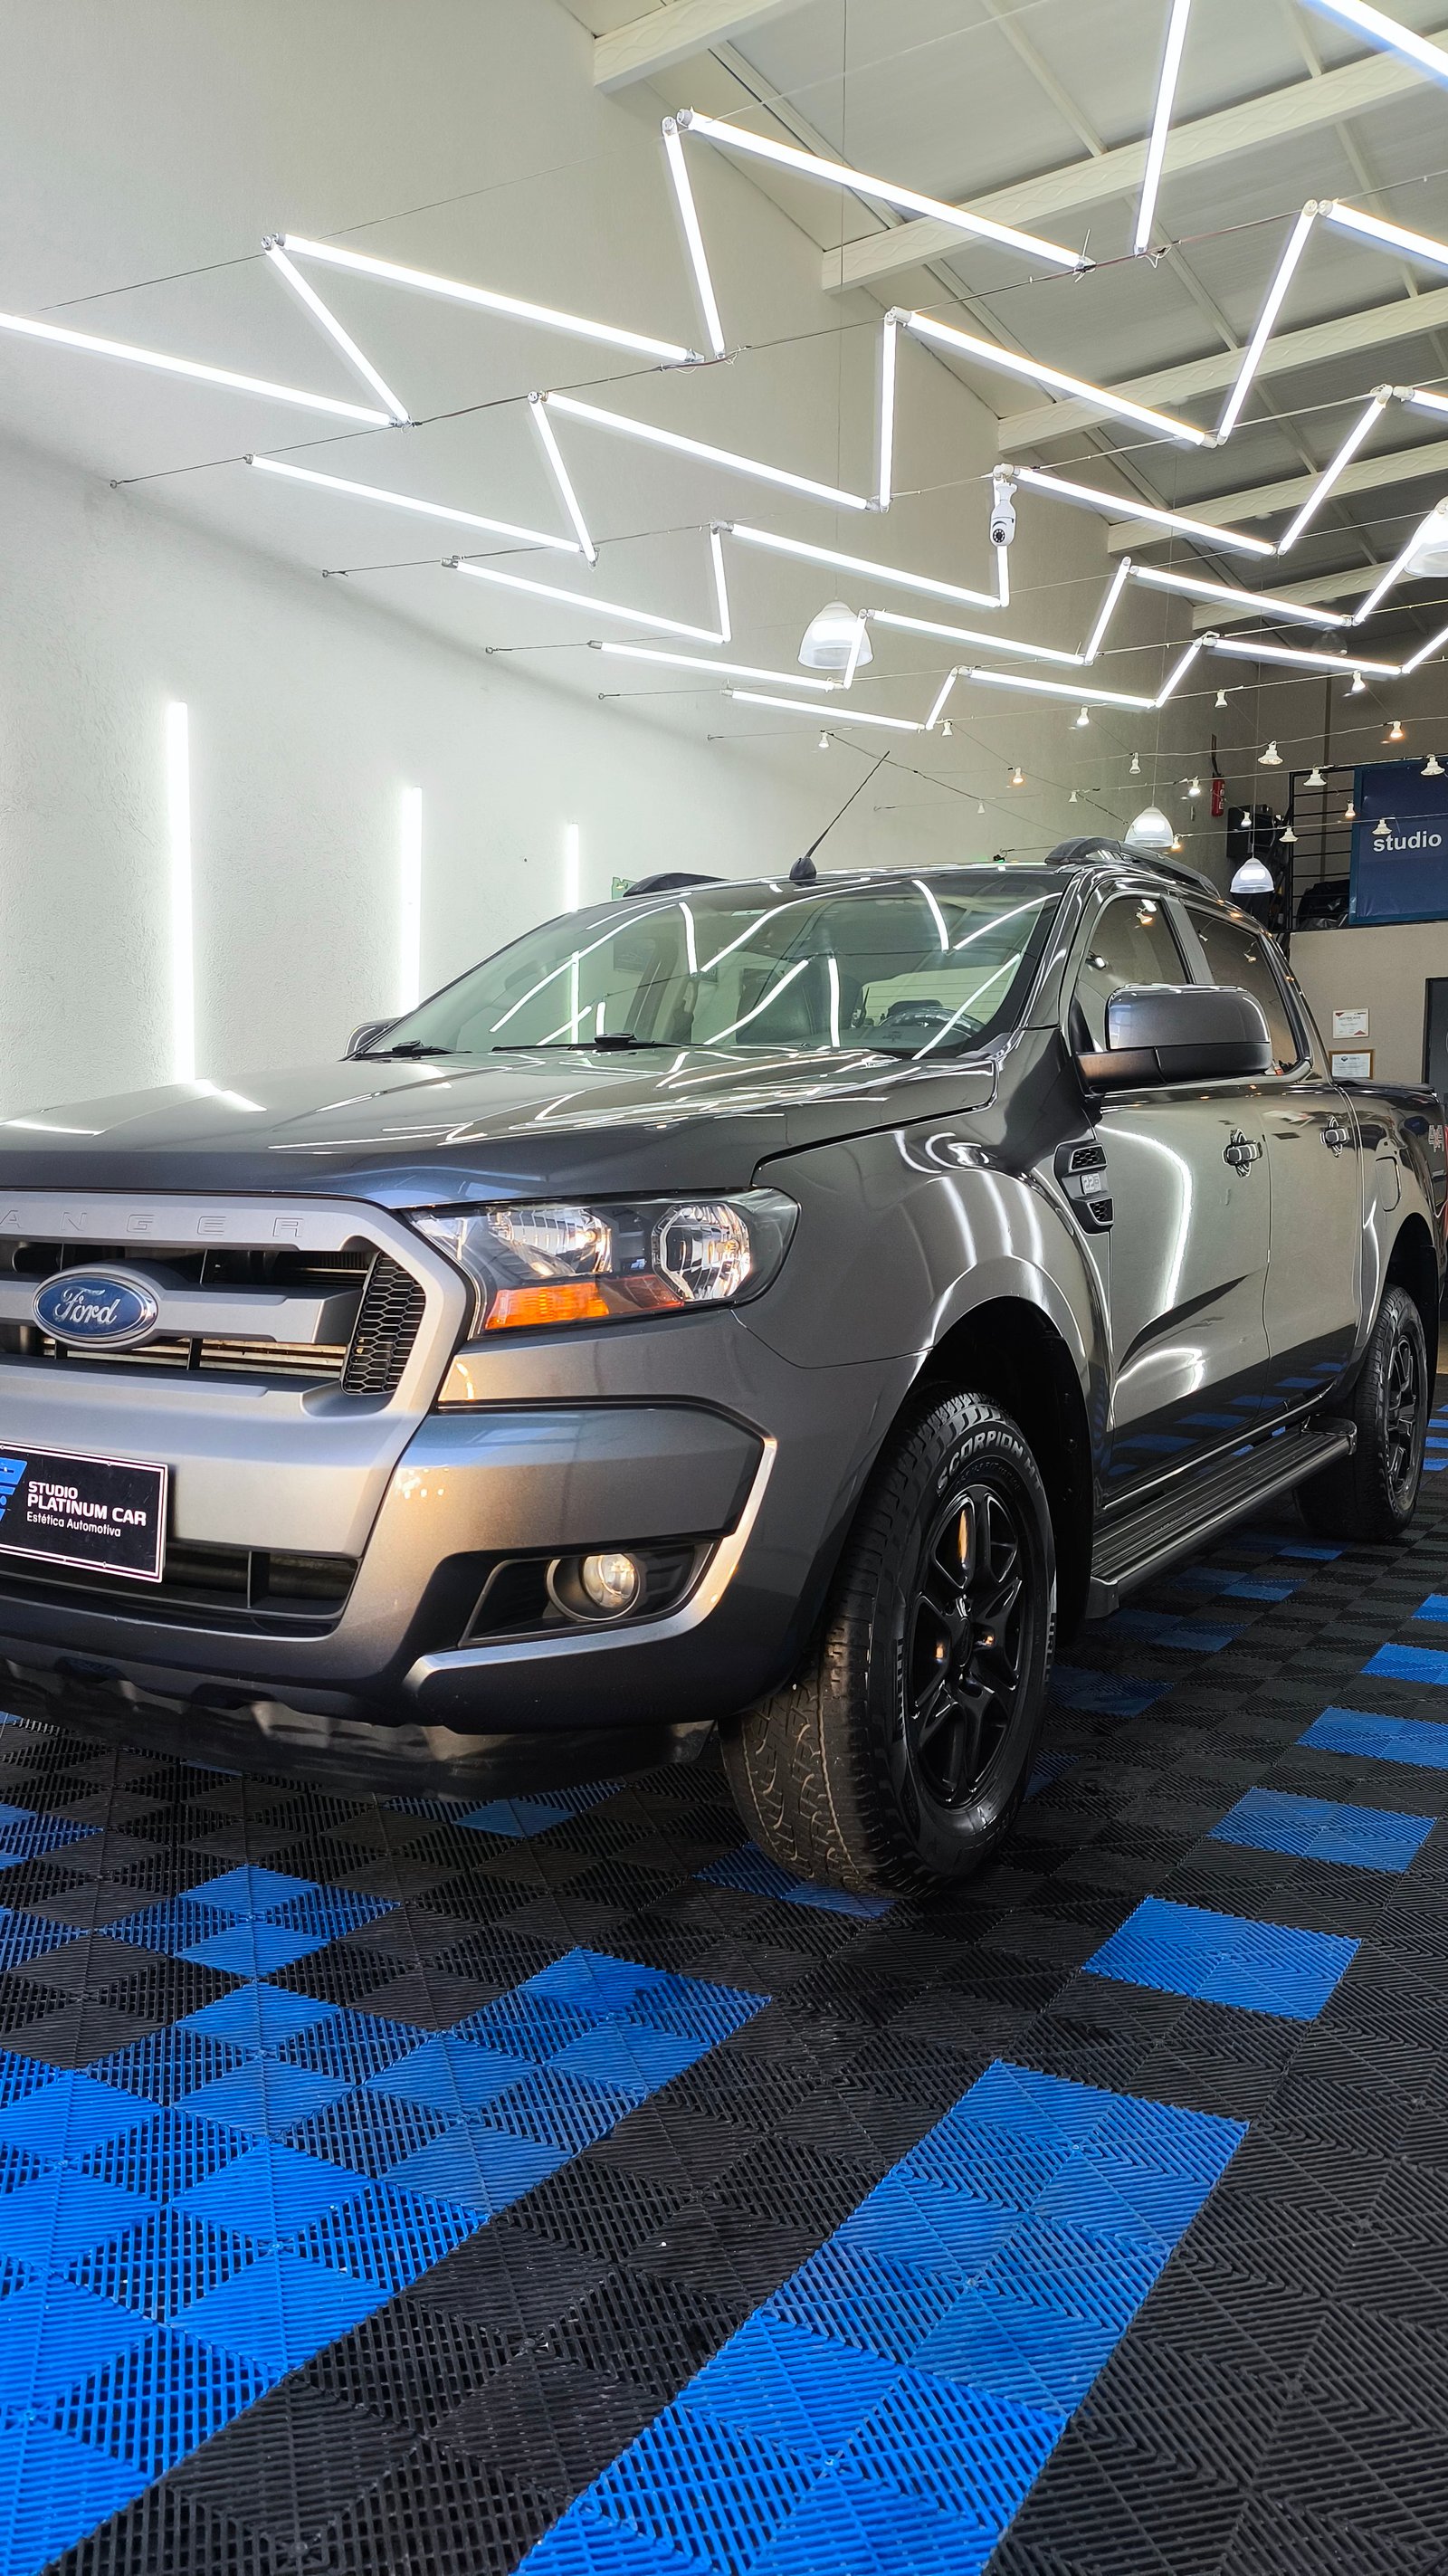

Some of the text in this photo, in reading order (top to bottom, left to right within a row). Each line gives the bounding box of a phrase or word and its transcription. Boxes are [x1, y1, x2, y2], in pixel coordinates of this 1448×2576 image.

[1373, 830, 1443, 853] studio
[52, 1286, 122, 1326] Ford
[937, 1430, 1024, 1498] SCORPION
[28, 1480, 79, 1500] STUDIO
[26, 1511, 121, 1537] Estética Automotiva
[27, 1493, 147, 1527] PLATINUM CAR
